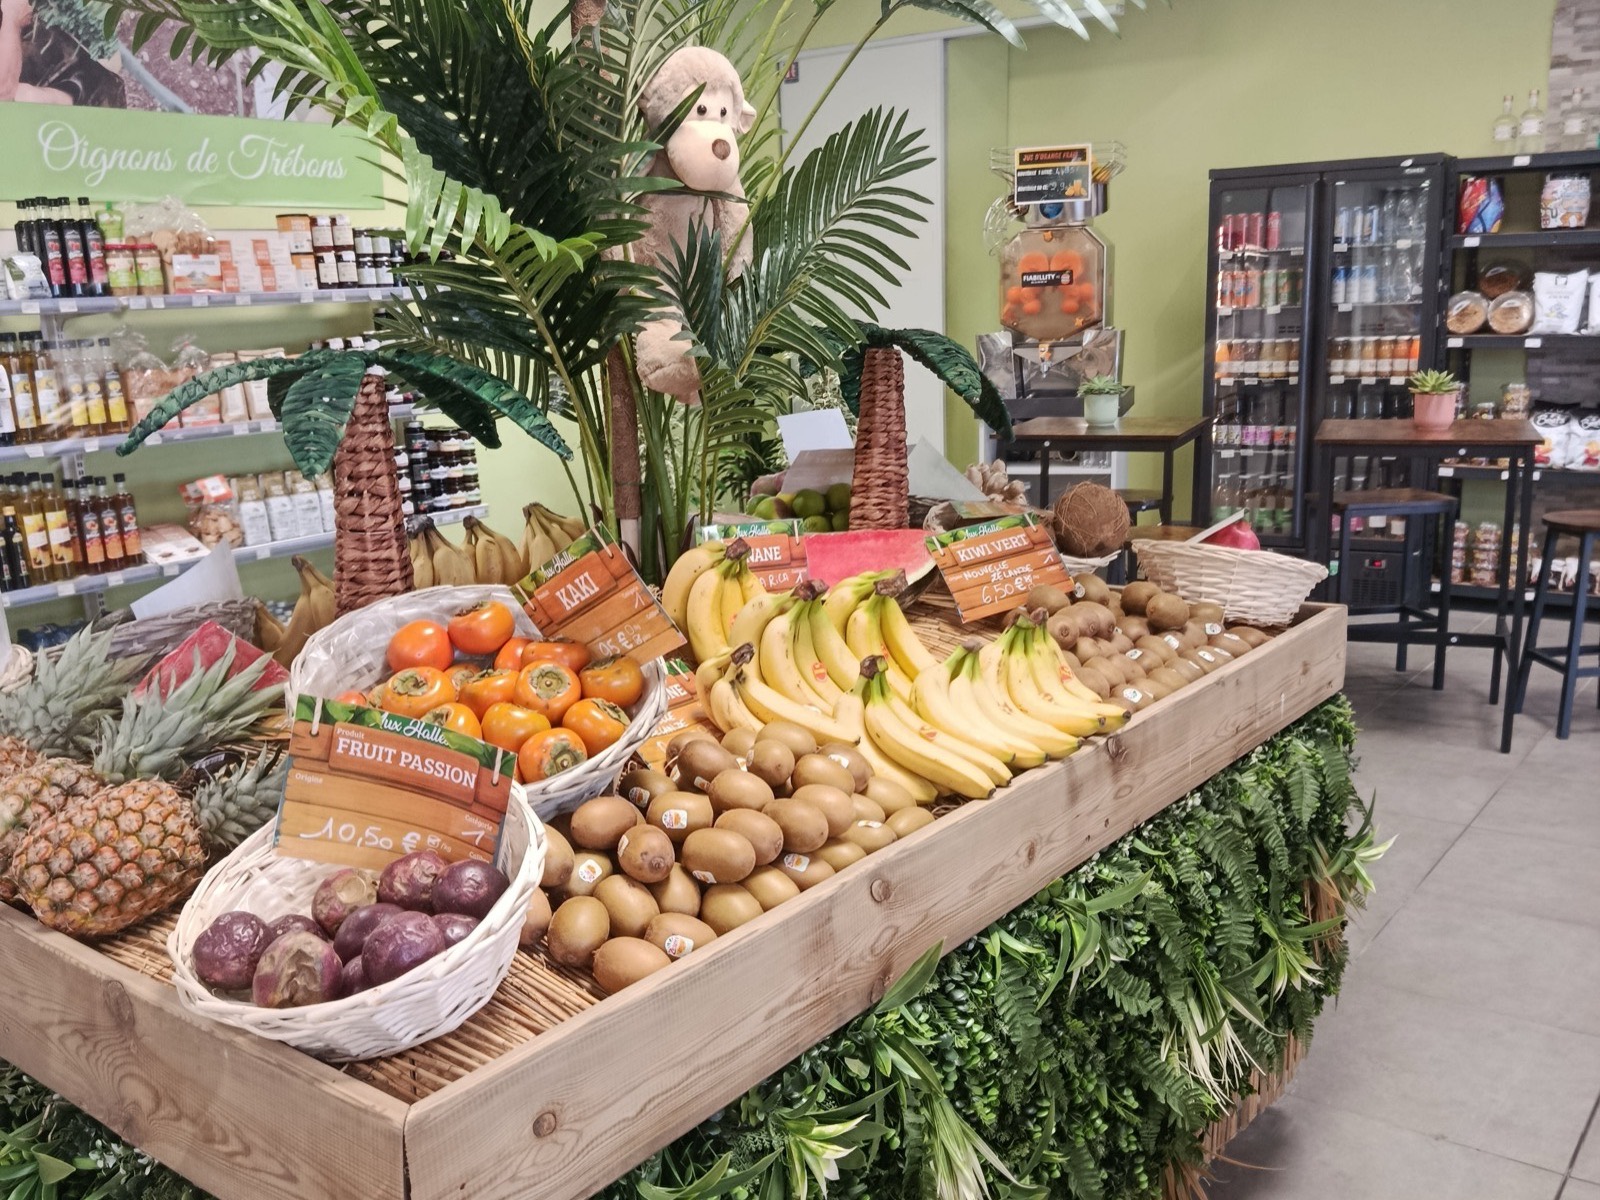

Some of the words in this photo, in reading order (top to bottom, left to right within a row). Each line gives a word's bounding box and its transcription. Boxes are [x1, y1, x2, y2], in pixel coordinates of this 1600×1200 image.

[38, 120, 177, 187] Oignons
[187, 138, 219, 173] de
[228, 134, 348, 179] Trébons
[746, 546, 782, 563] NANE
[956, 545, 993, 562] KIWI
[990, 533, 1031, 556] VERT
[555, 571, 600, 612] KAKI
[981, 583, 1016, 605] 6,50
[336, 727, 365, 740] Produit
[336, 737, 397, 765] FRUIT
[399, 751, 477, 790] PASSION
[295, 772, 325, 786] Origine
[299, 816, 394, 850] 10,50
